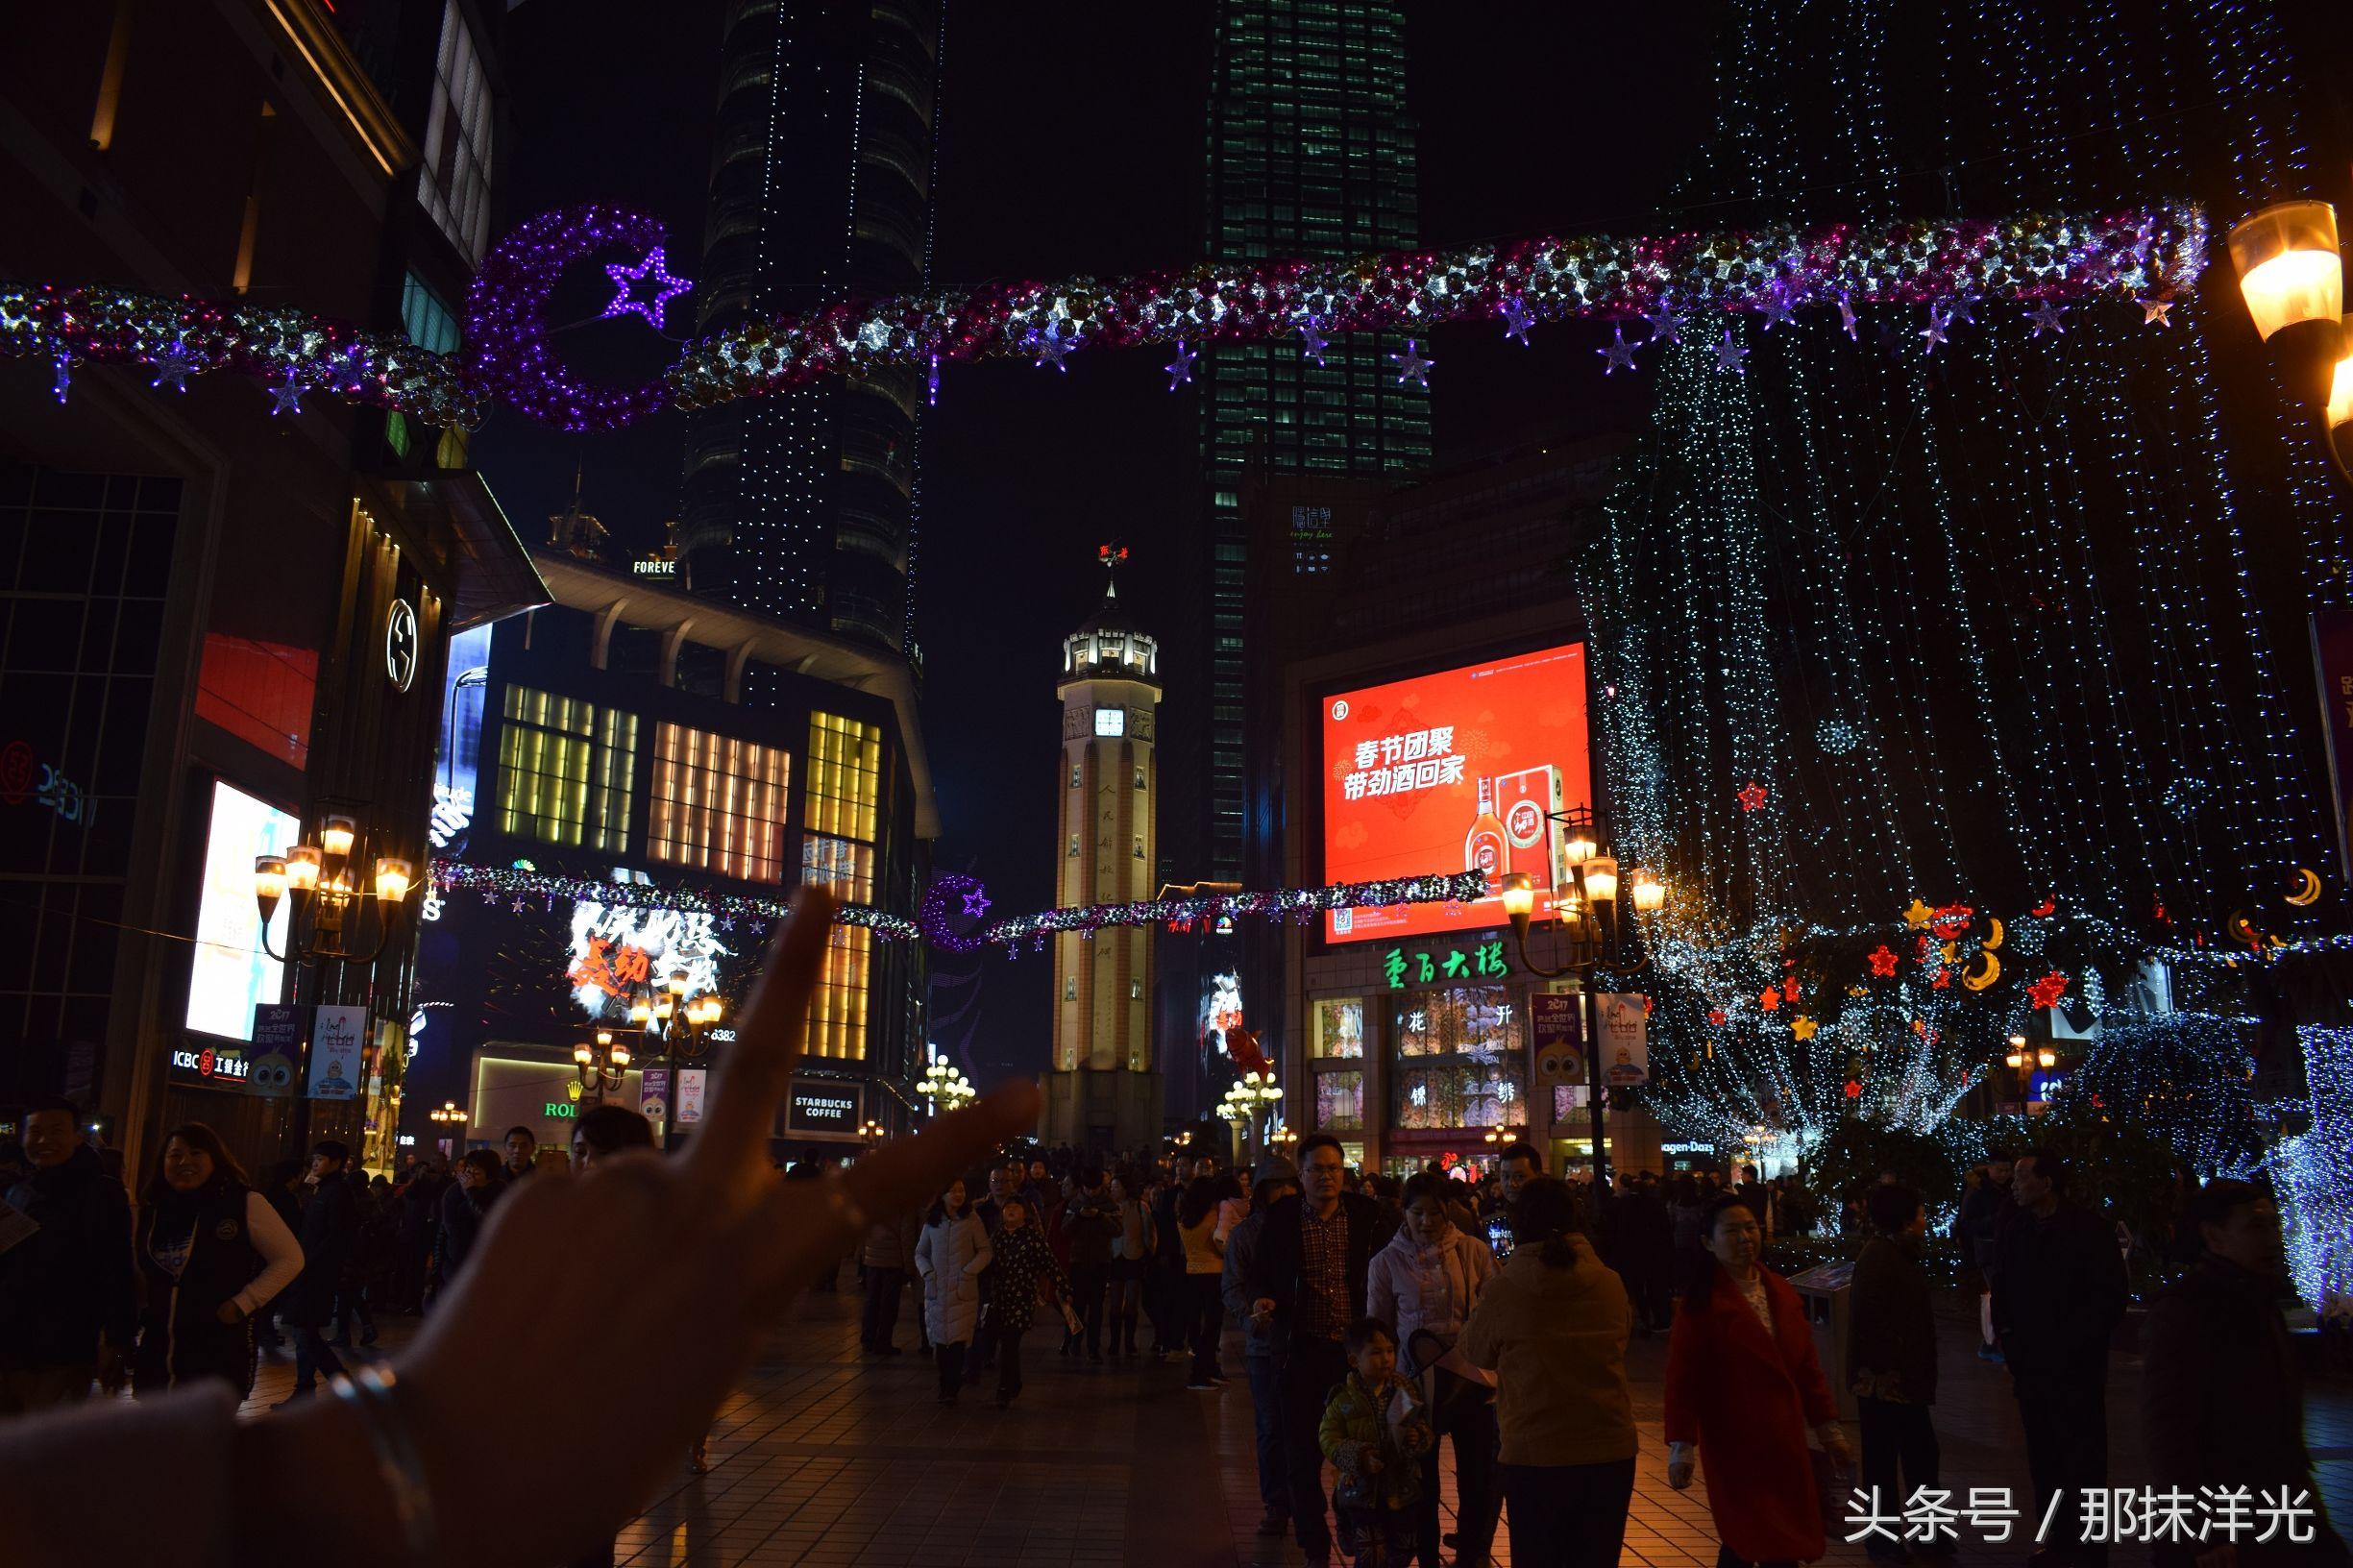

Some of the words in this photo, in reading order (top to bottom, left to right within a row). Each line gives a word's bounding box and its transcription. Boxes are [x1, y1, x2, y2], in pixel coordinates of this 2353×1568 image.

[1356, 726, 1454, 769] 春节团聚
[1344, 755, 1465, 800] 带劲酒回家
[1408, 1011, 1426, 1033] 花
[1496, 1004, 1513, 1026] 开
[173, 1050, 199, 1069] ICBC
[796, 1096, 852, 1109] STARBUCKS
[1410, 1085, 1427, 1107] 锦
[1497, 1082, 1515, 1104] 绣
[805, 1108, 842, 1118] COFFEE
